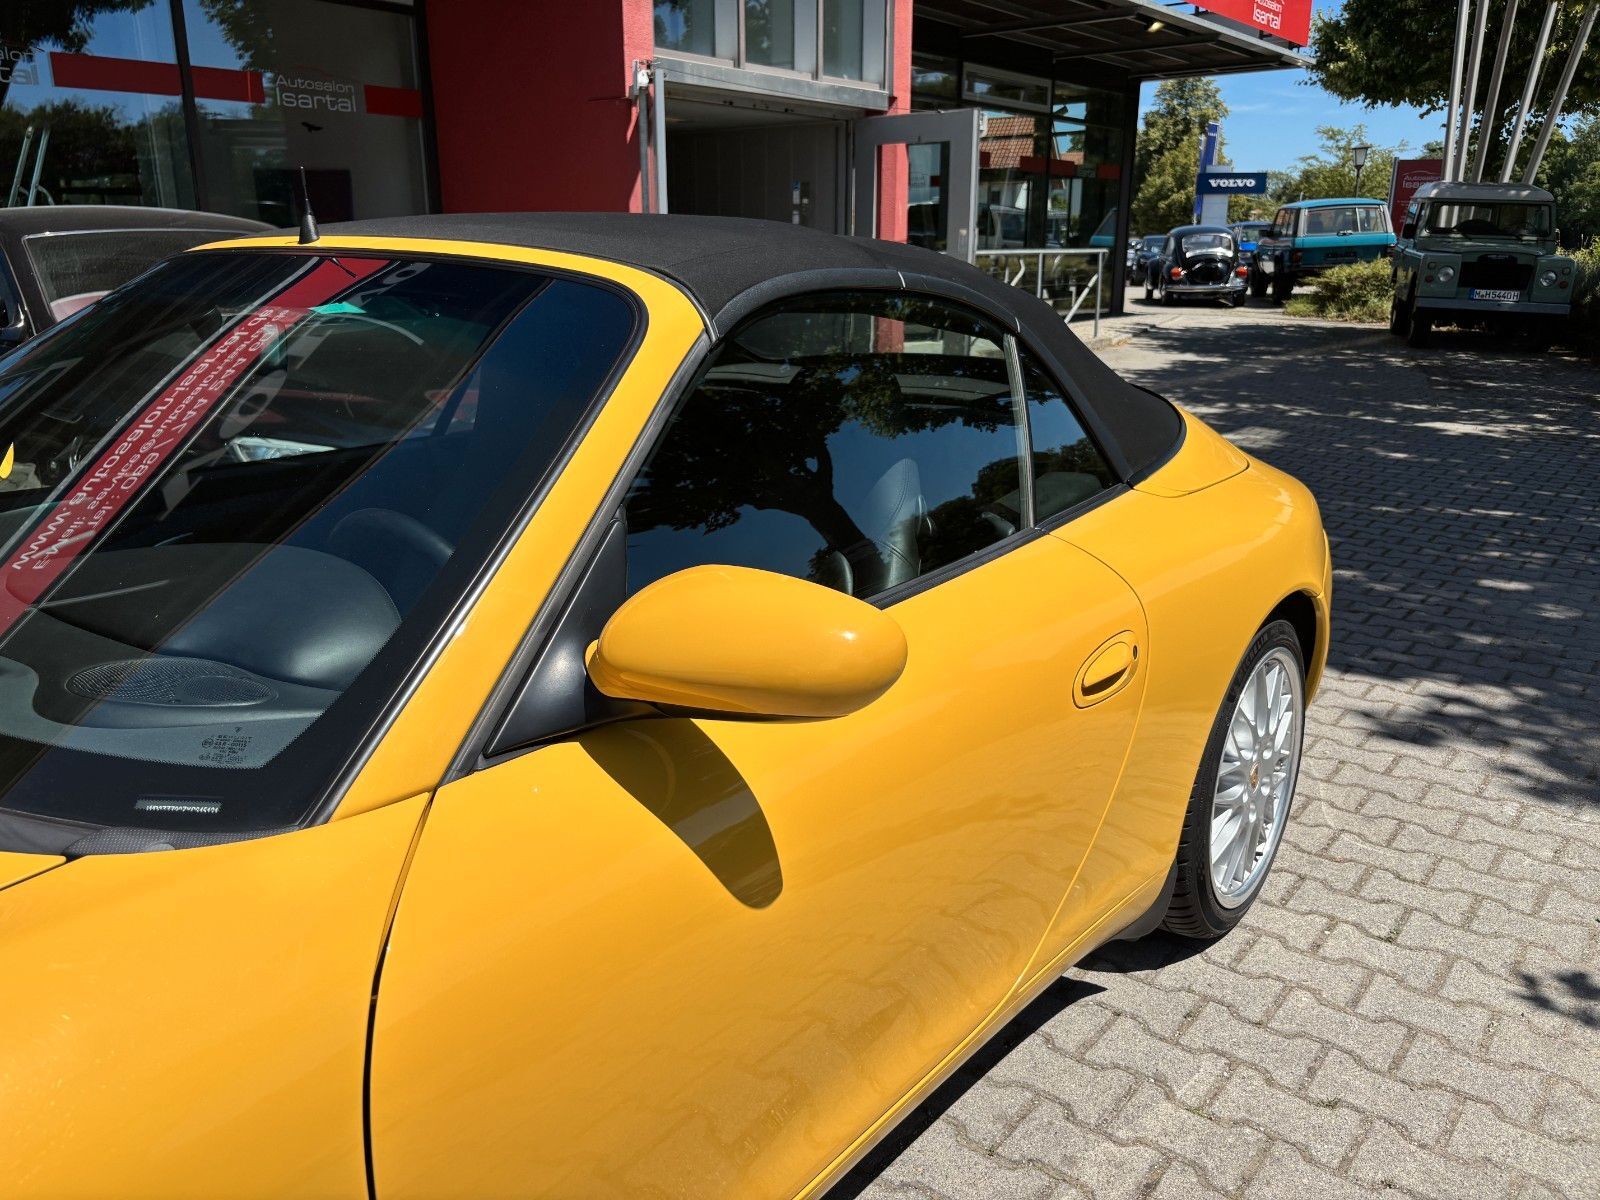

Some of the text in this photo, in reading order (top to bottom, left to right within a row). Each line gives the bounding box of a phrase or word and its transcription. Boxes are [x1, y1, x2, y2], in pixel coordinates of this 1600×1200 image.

[1253, 3, 1282, 30] Isartal
[275, 74, 355, 93] Autosalon
[275, 87, 357, 113] Isartal
[1208, 178, 1256, 188] VOLVO
